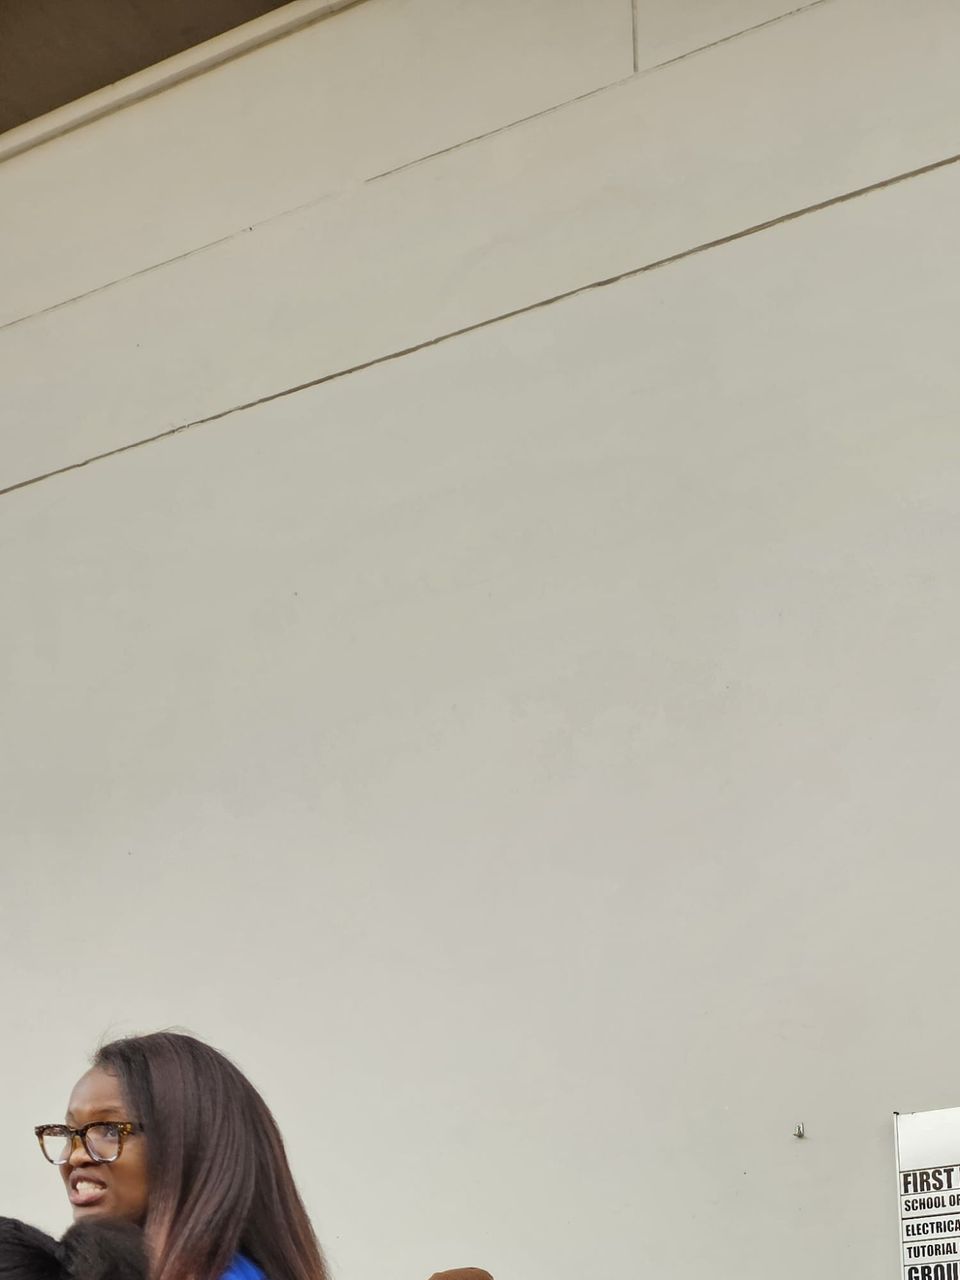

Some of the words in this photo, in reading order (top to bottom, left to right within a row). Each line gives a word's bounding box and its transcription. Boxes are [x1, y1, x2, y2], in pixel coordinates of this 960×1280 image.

[903, 1168, 954, 1193] FIRST
[904, 1194, 946, 1212] SCHOOL
[949, 1194, 960, 1207] OF
[907, 1243, 957, 1258] TUTORIAL
